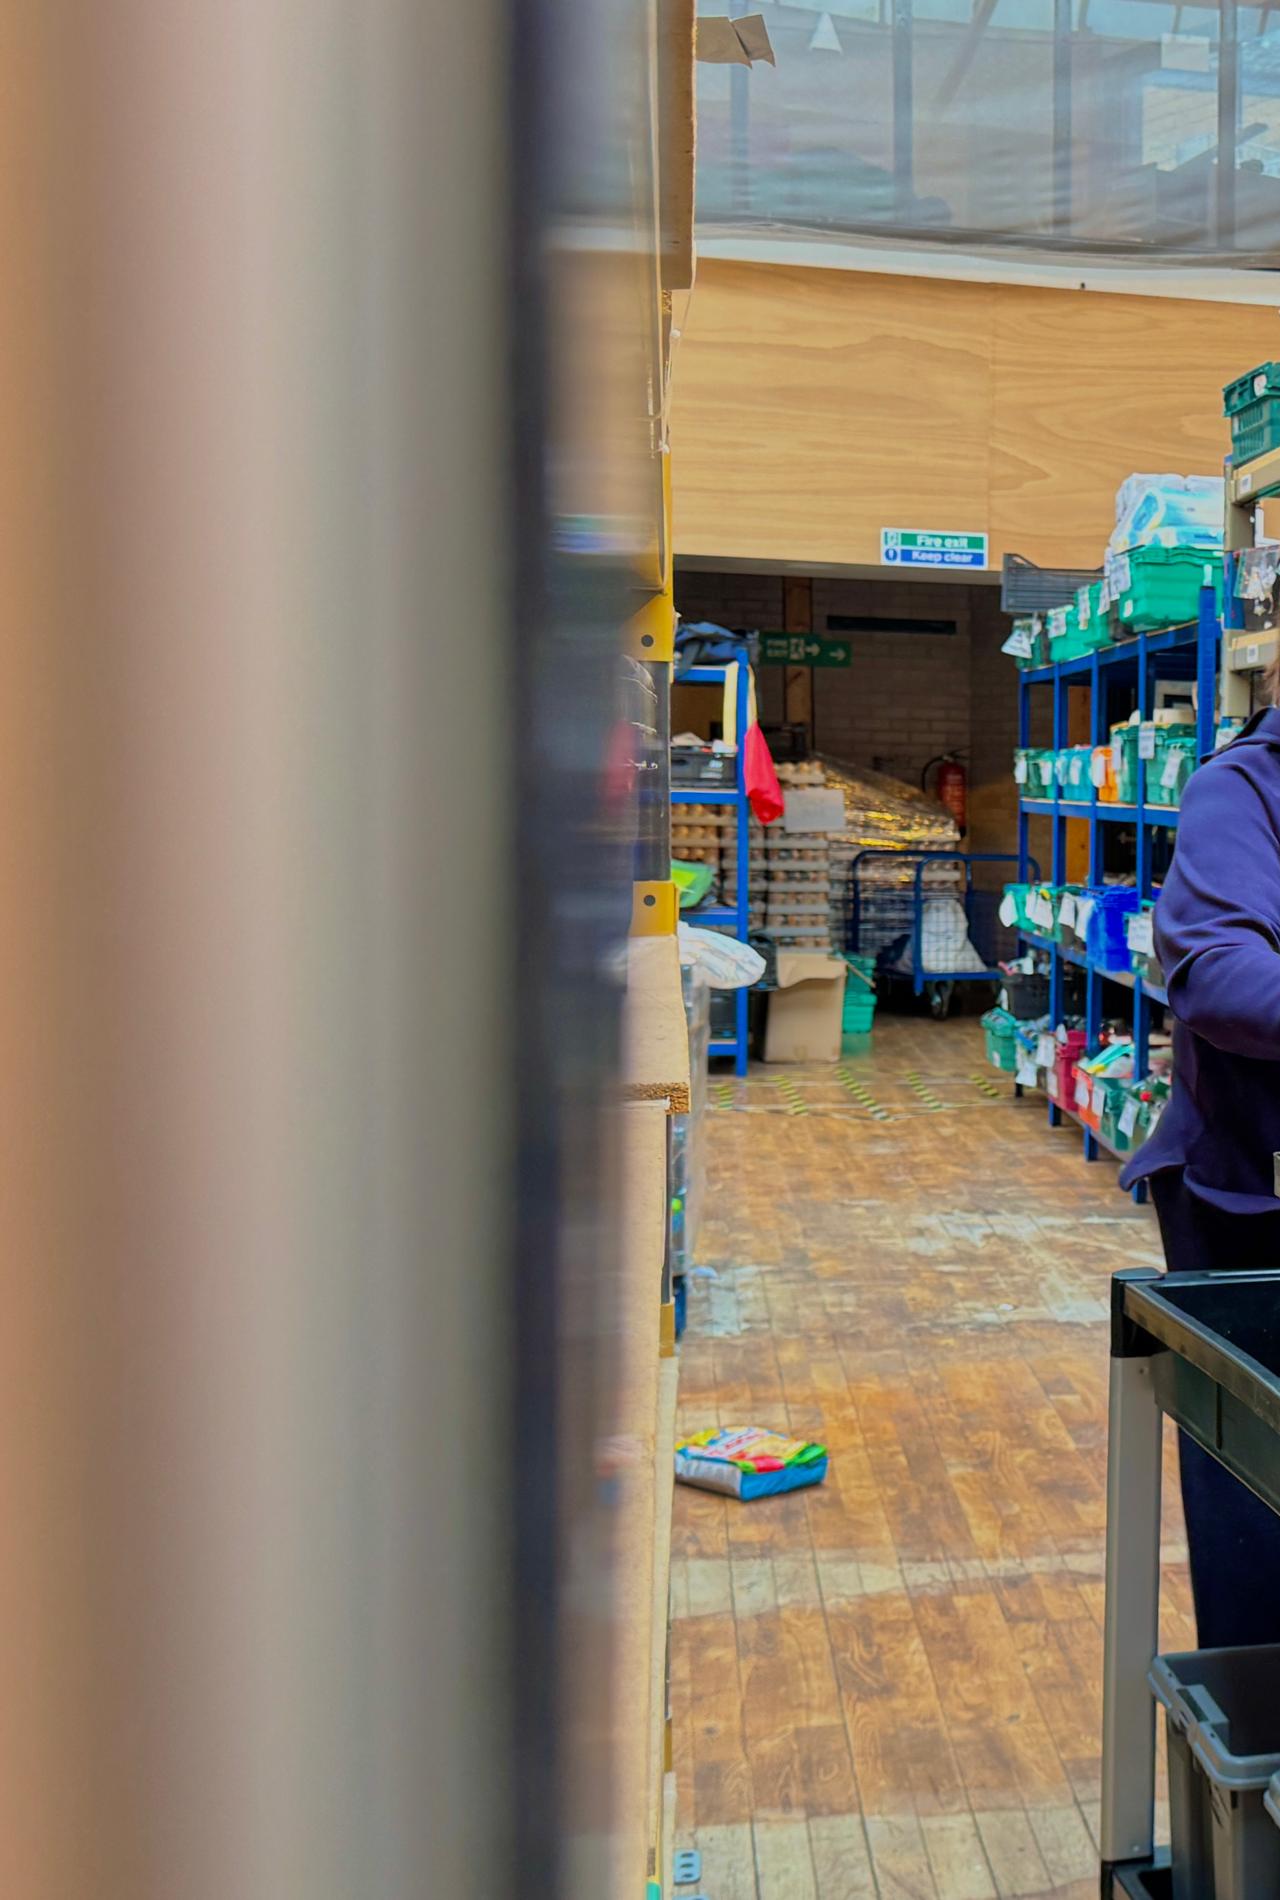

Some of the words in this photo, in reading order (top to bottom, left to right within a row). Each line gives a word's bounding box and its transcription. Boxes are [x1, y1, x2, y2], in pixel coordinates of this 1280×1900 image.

[917, 535, 942, 547] Fire
[944, 537, 968, 549] exit
[912, 551, 942, 563] Keep
[944, 553, 973, 562] clear
